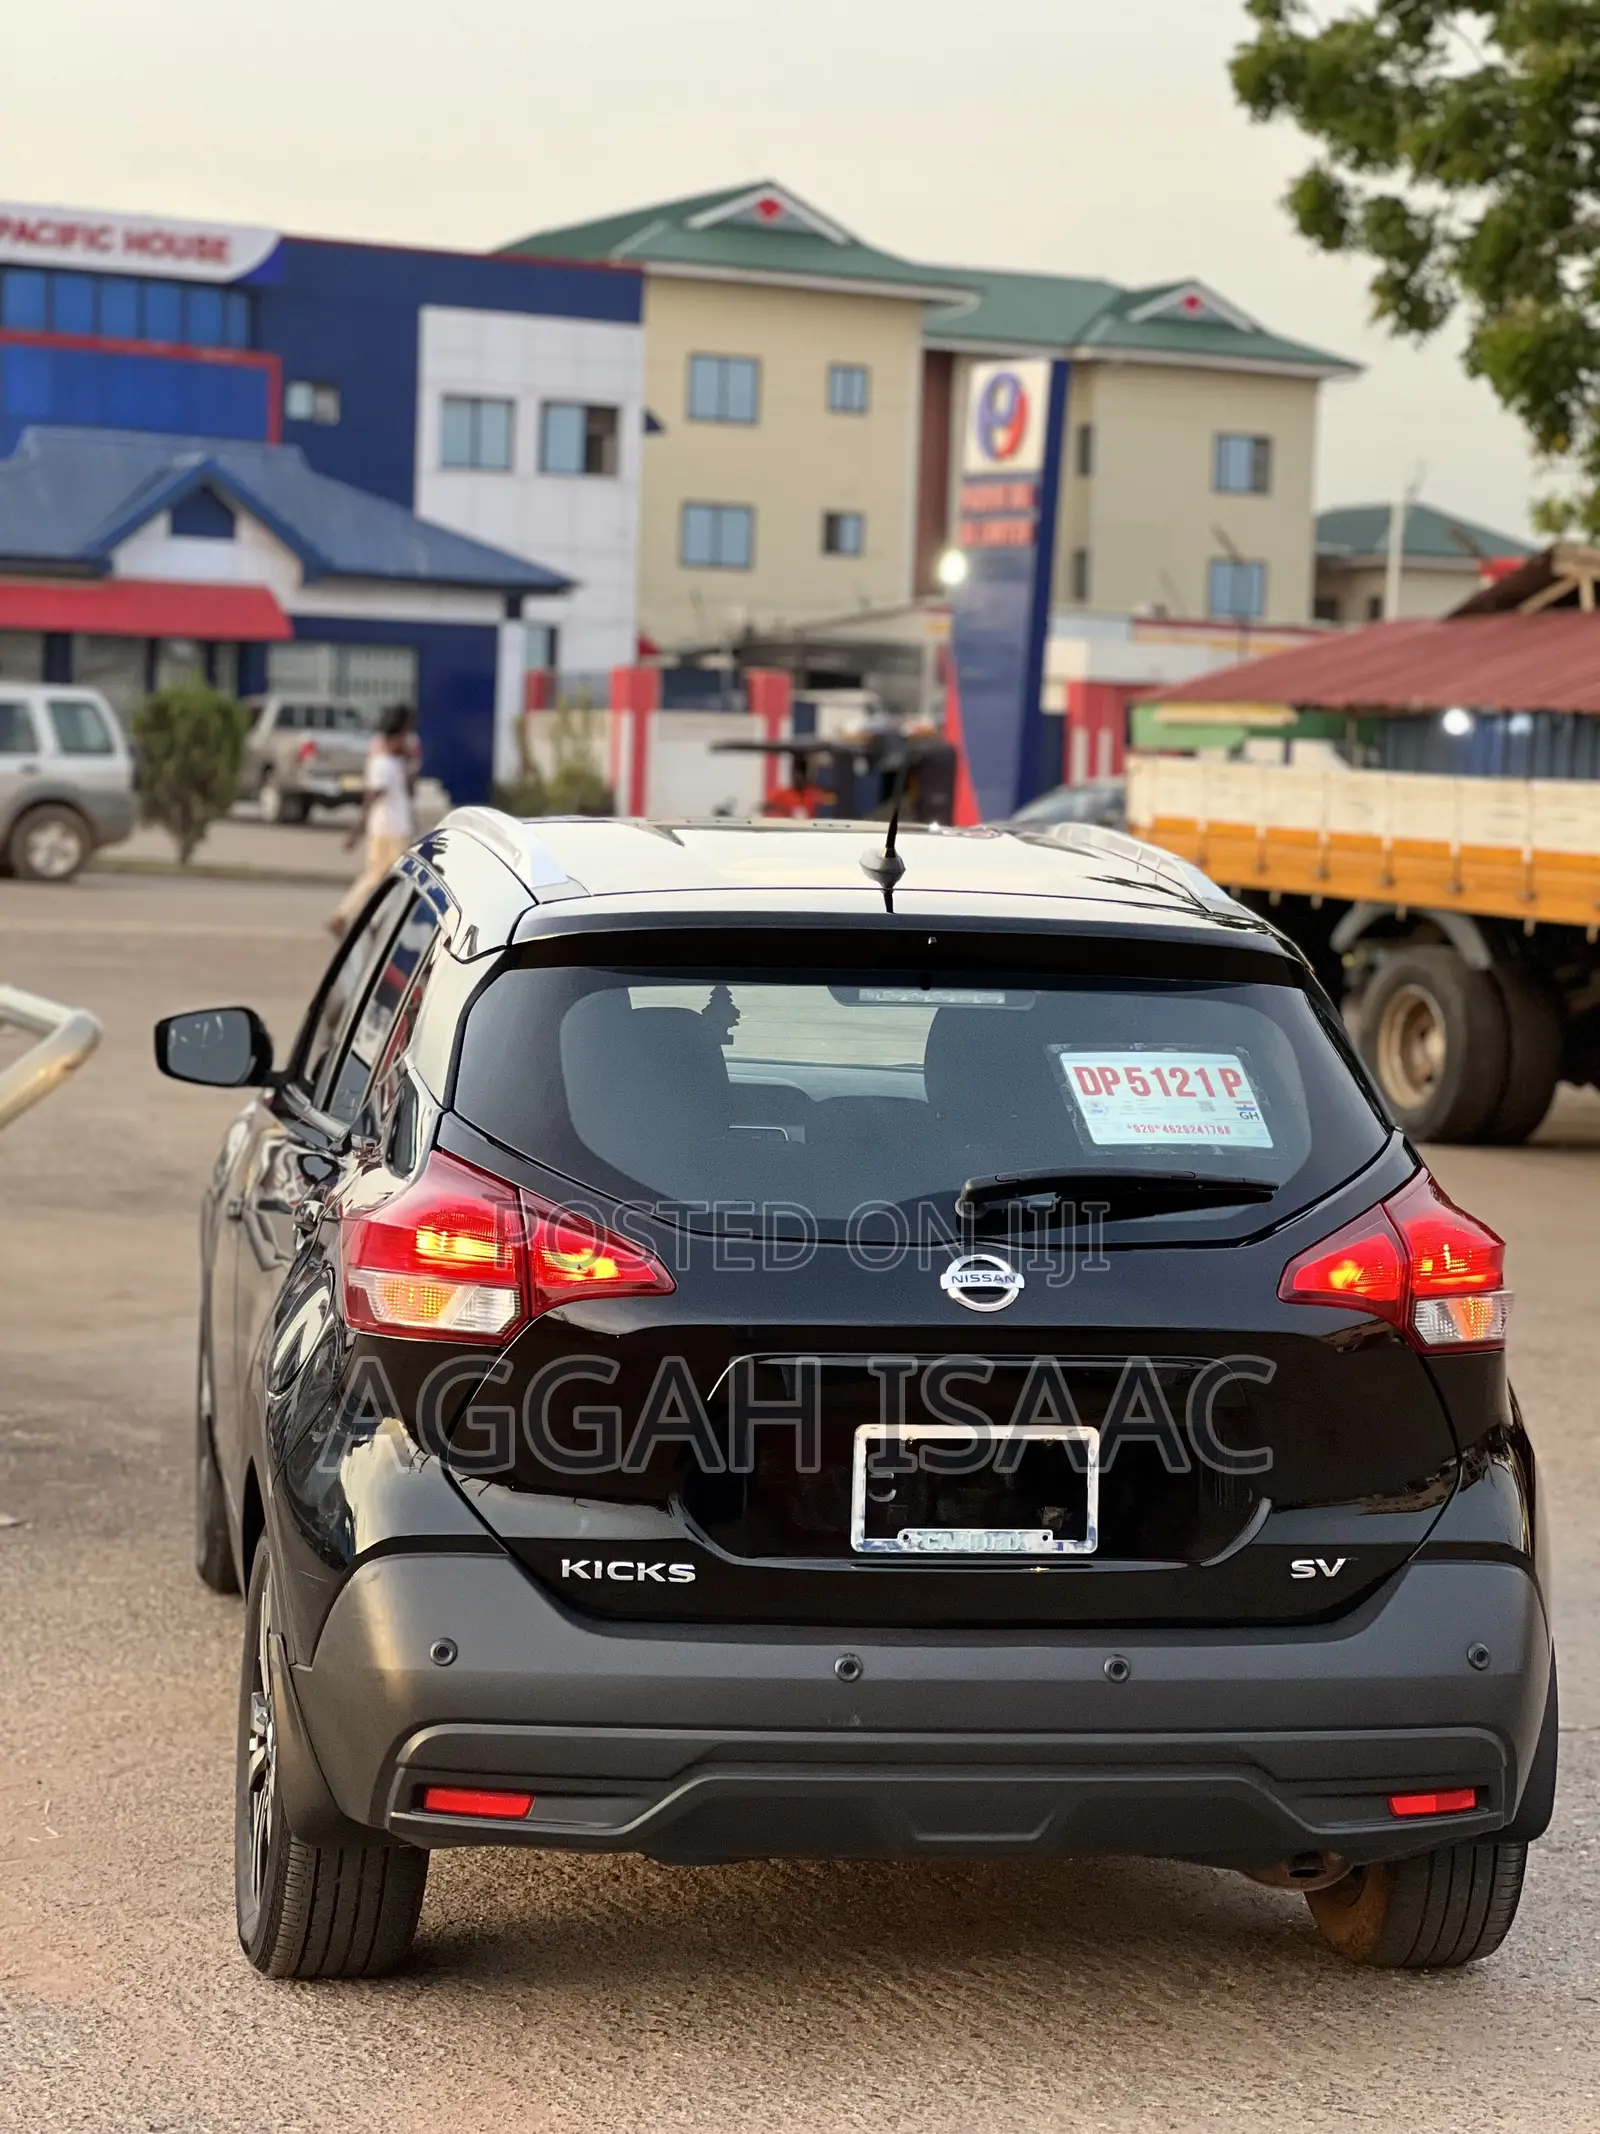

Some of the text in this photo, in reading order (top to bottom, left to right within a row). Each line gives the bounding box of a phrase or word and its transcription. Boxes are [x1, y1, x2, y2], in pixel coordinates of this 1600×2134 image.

[122, 227, 230, 266] HOUSE
[1239, 1112, 1260, 1121] GH
[951, 1274, 1016, 1284] NISSAN
[561, 1559, 696, 1583] KICKS
[1290, 1558, 1347, 1579] SV
